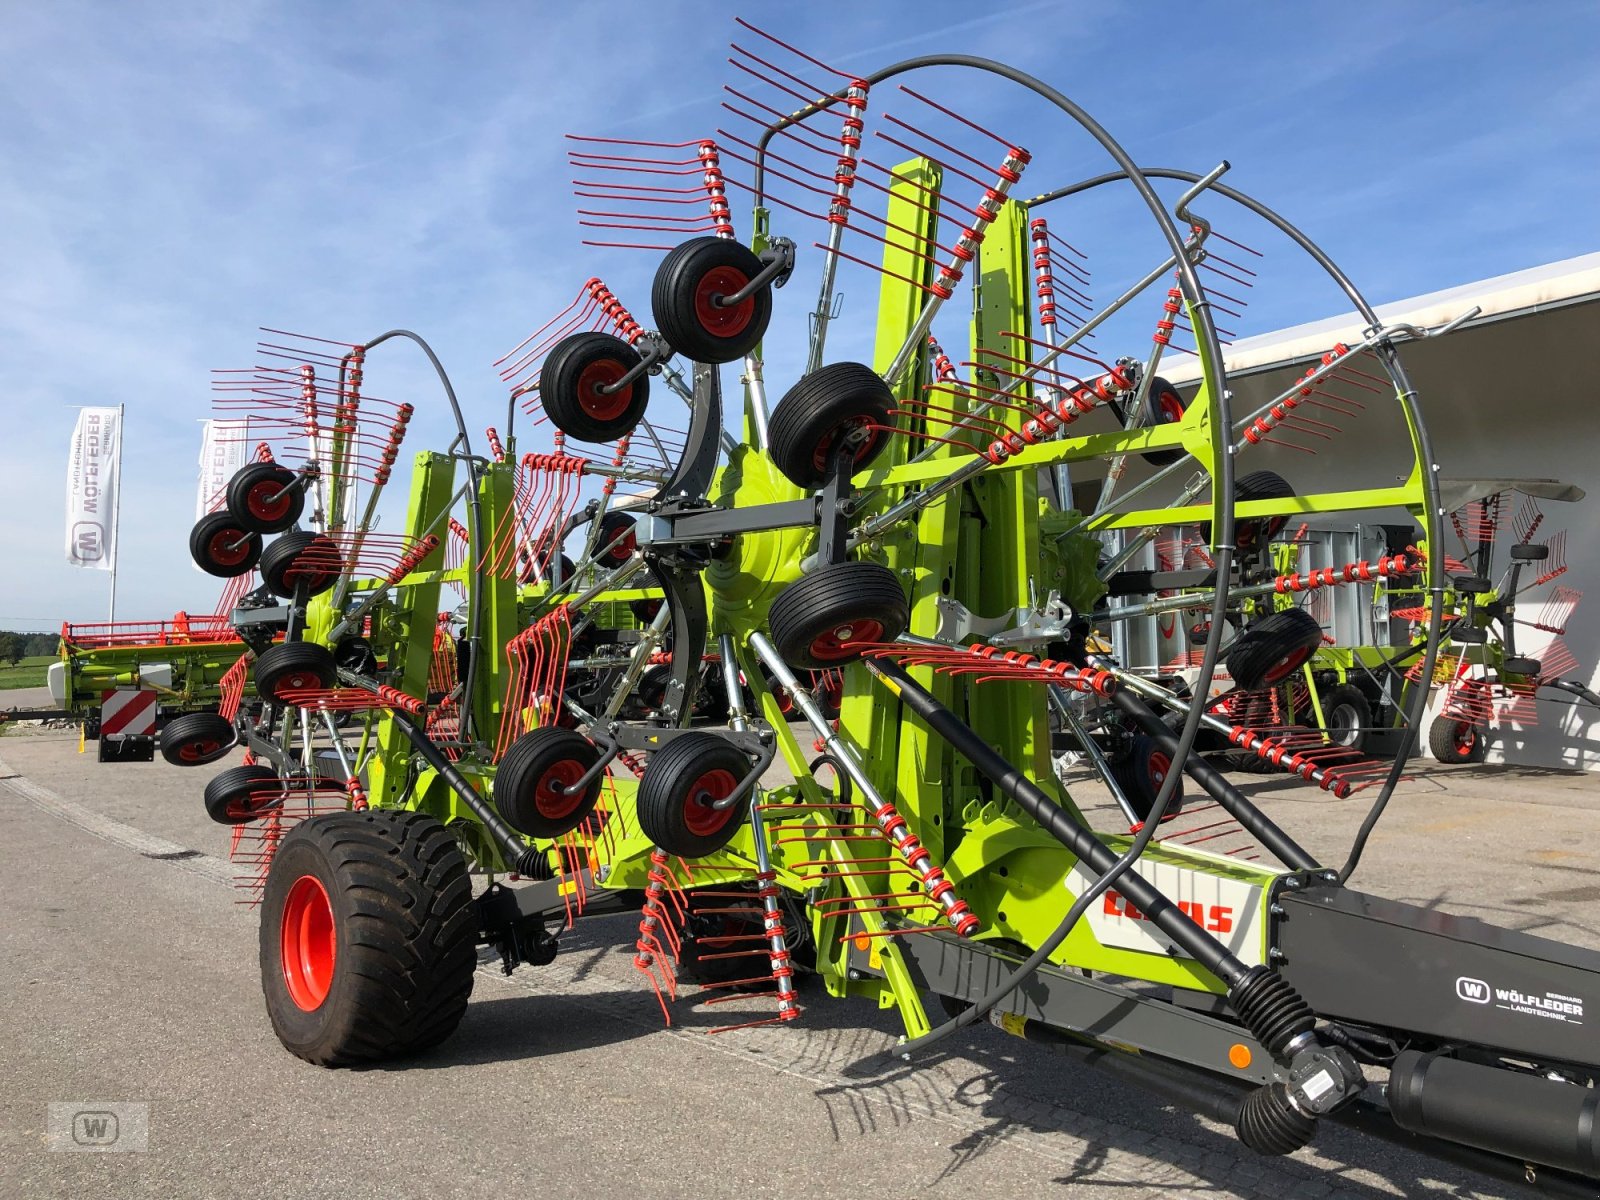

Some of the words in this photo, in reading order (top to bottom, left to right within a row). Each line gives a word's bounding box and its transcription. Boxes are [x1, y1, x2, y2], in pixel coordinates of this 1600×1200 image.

[1103, 890, 1233, 933] CLAS
[1463, 982, 1483, 998] W
[1545, 992, 1583, 1004] BERNHARD
[1495, 988, 1583, 1016] WÖLFLEDER
[1510, 1004, 1567, 1021] LANDTECHNIK
